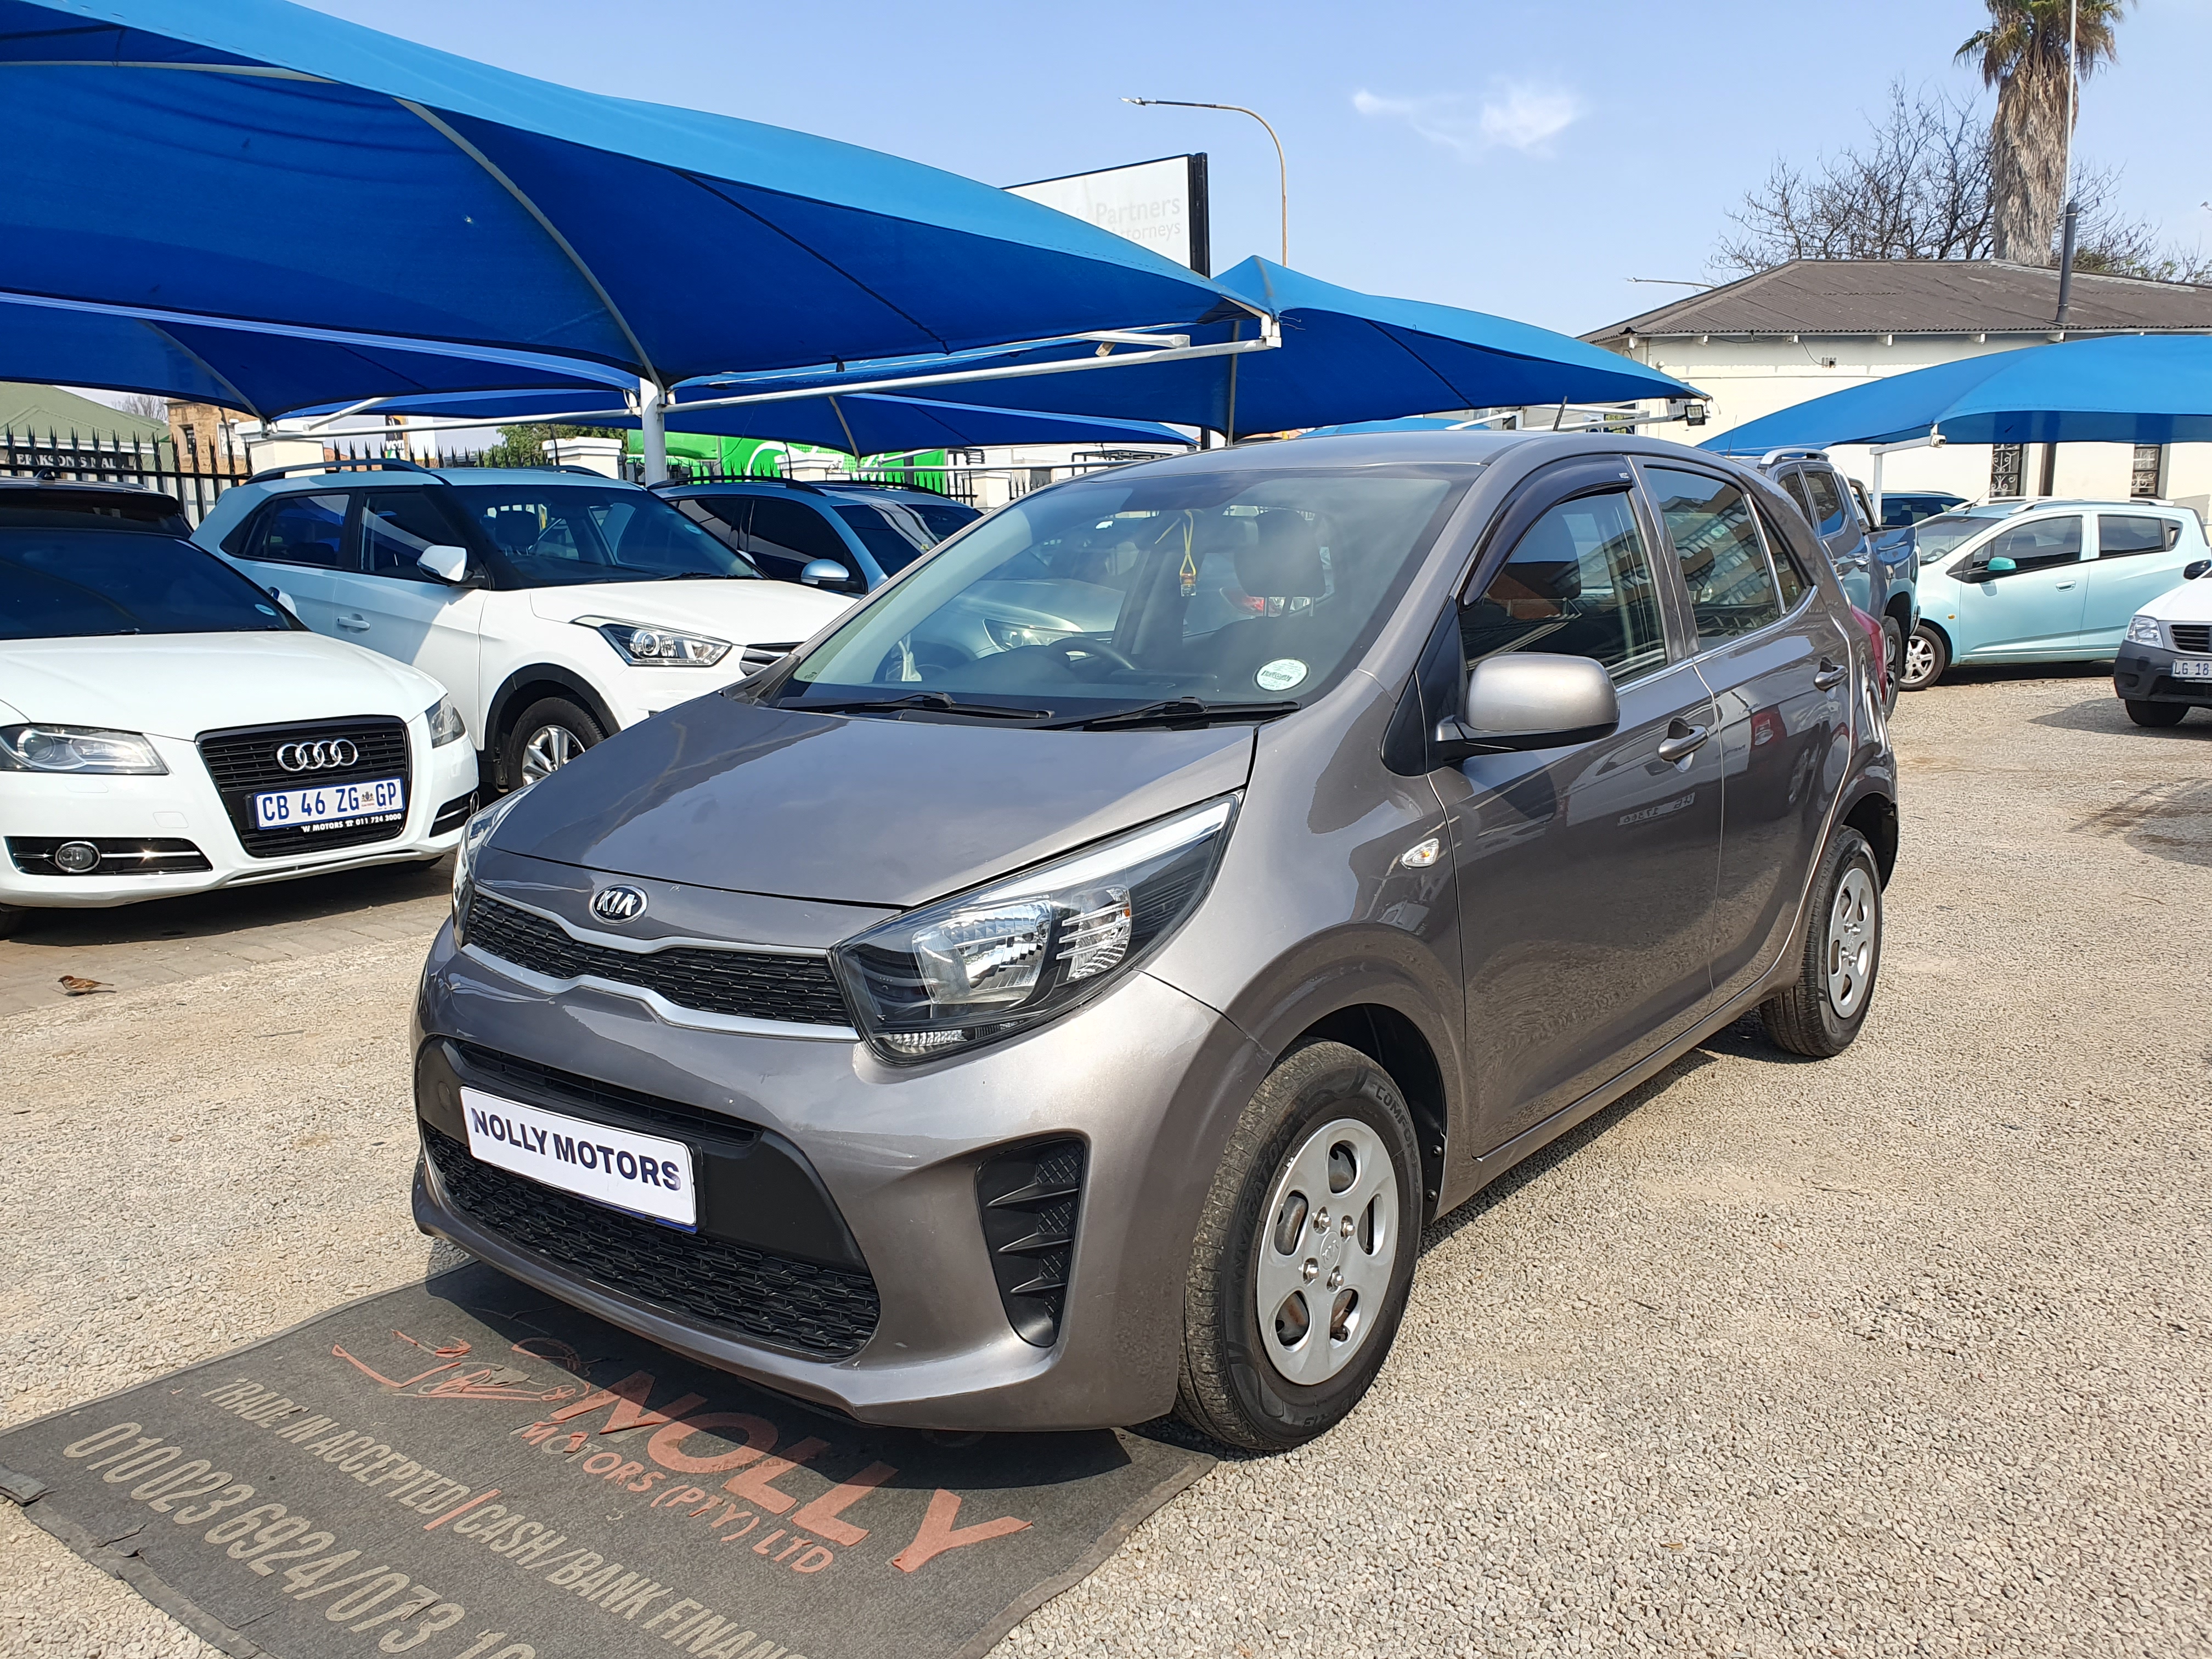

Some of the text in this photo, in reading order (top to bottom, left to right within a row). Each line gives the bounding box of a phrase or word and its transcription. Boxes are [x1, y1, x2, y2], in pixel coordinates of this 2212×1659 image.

[1096, 198, 1181, 225] Partners
[1112, 222, 1181, 241] torneys
[2174, 662, 2209, 675] LG 18
[262, 782, 397, 821] CB 46 ZG GP
[313, 821, 343, 831] MOTORS
[356, 817, 368, 826] 011
[385, 813, 402, 821] 3000
[596, 890, 635, 916] KIA
[471, 1108, 681, 1191] NOLLY MOTORS
[200, 1378, 309, 1428] TRADE
[275, 1414, 340, 1443] IN
[303, 1430, 471, 1515] ACCEPTED
[550, 1370, 1033, 1573] NOLLY
[752, 1528, 833, 1573] LTD
[642, 1597, 809, 1659] FINAN
